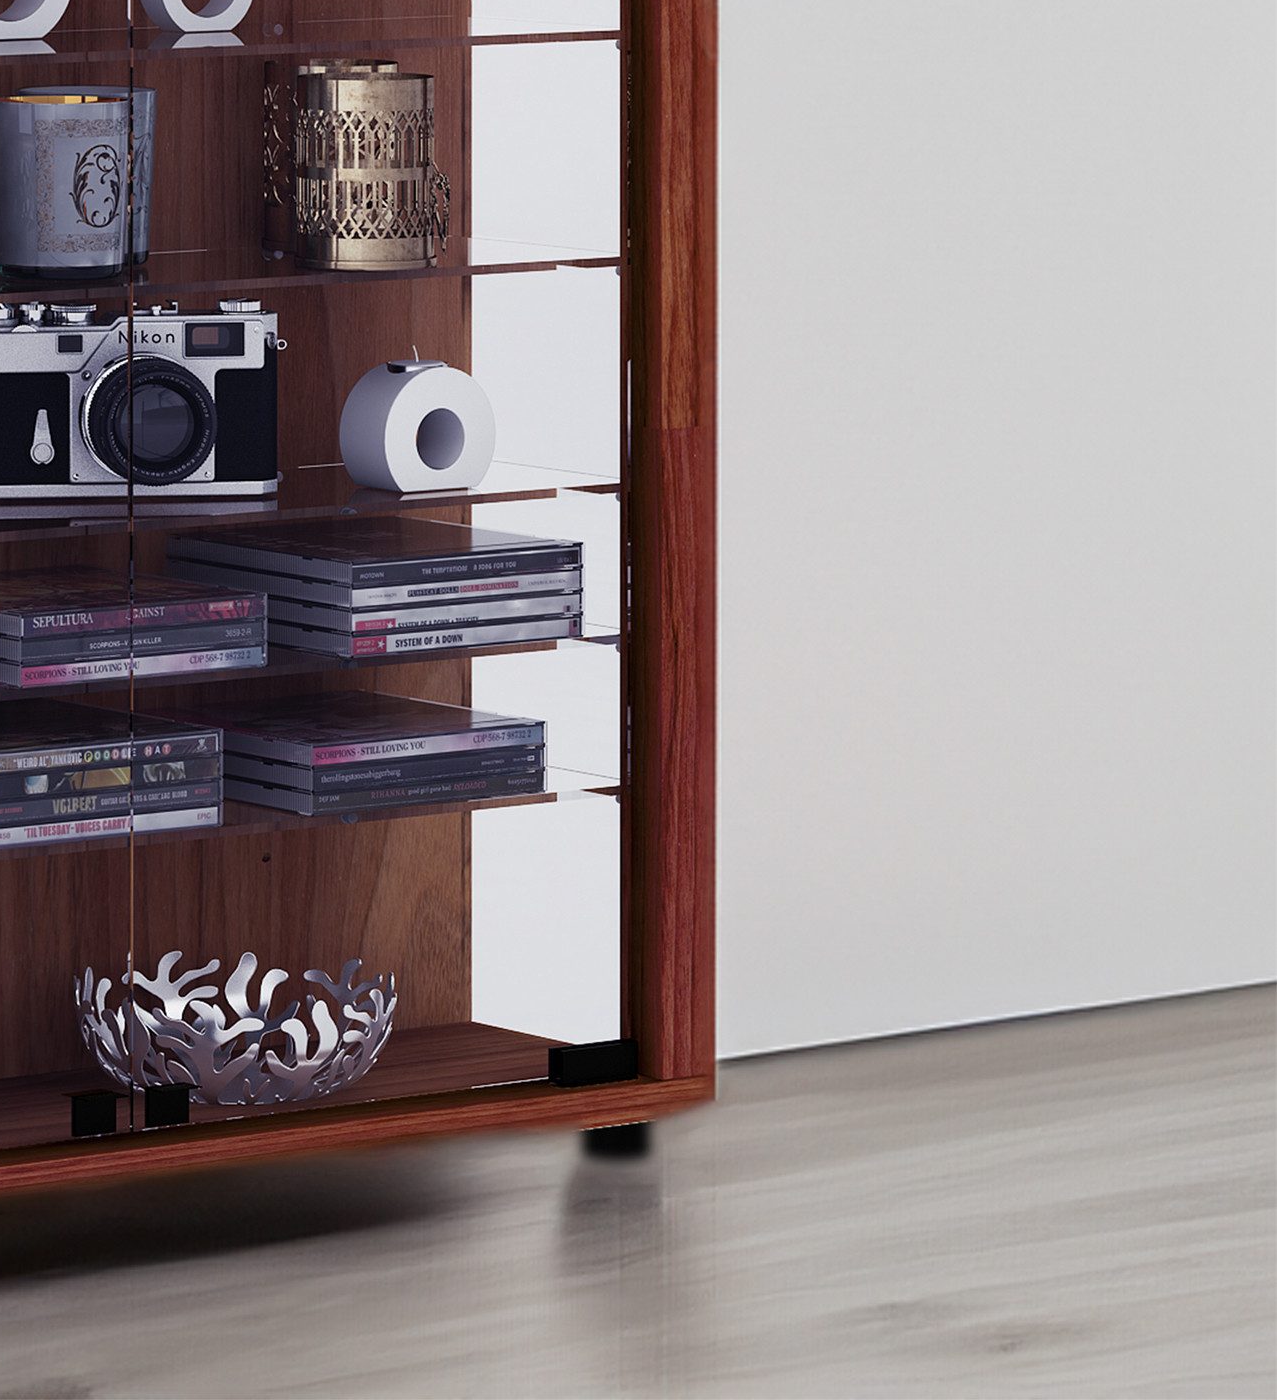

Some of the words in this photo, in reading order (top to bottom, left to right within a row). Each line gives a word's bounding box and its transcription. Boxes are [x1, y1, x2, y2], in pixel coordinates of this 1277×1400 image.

[118, 329, 175, 344] Nikon
[33, 613, 94, 629] SEPULTURA
[395, 637, 422, 648] SYSTEM
[424, 636, 434, 646] OF
[435, 636, 441, 644] A
[442, 634, 464, 644] DOWN
[25, 668, 68, 681] SCORPIONS
[71, 666, 93, 676] STILL
[94, 663, 122, 675] LOVING
[189, 654, 205, 665] CDP
[247, 650, 251, 659] 2
[315, 748, 356, 760] SCORPIONS
[360, 746, 381, 756] STILL
[382, 743, 409, 753] LOVING
[410, 740, 426, 750] YOU
[473, 734, 487, 744] CDP
[527, 729, 532, 738] 2
[50, 752, 82, 767] YANKOVIC
[144, 743, 172, 757] HAT
[370, 789, 406, 799] RIHANNA
[38, 824, 71, 837] TUESDAY
[75, 820, 101, 834] VOICES
[102, 818, 128, 831] CARRY
